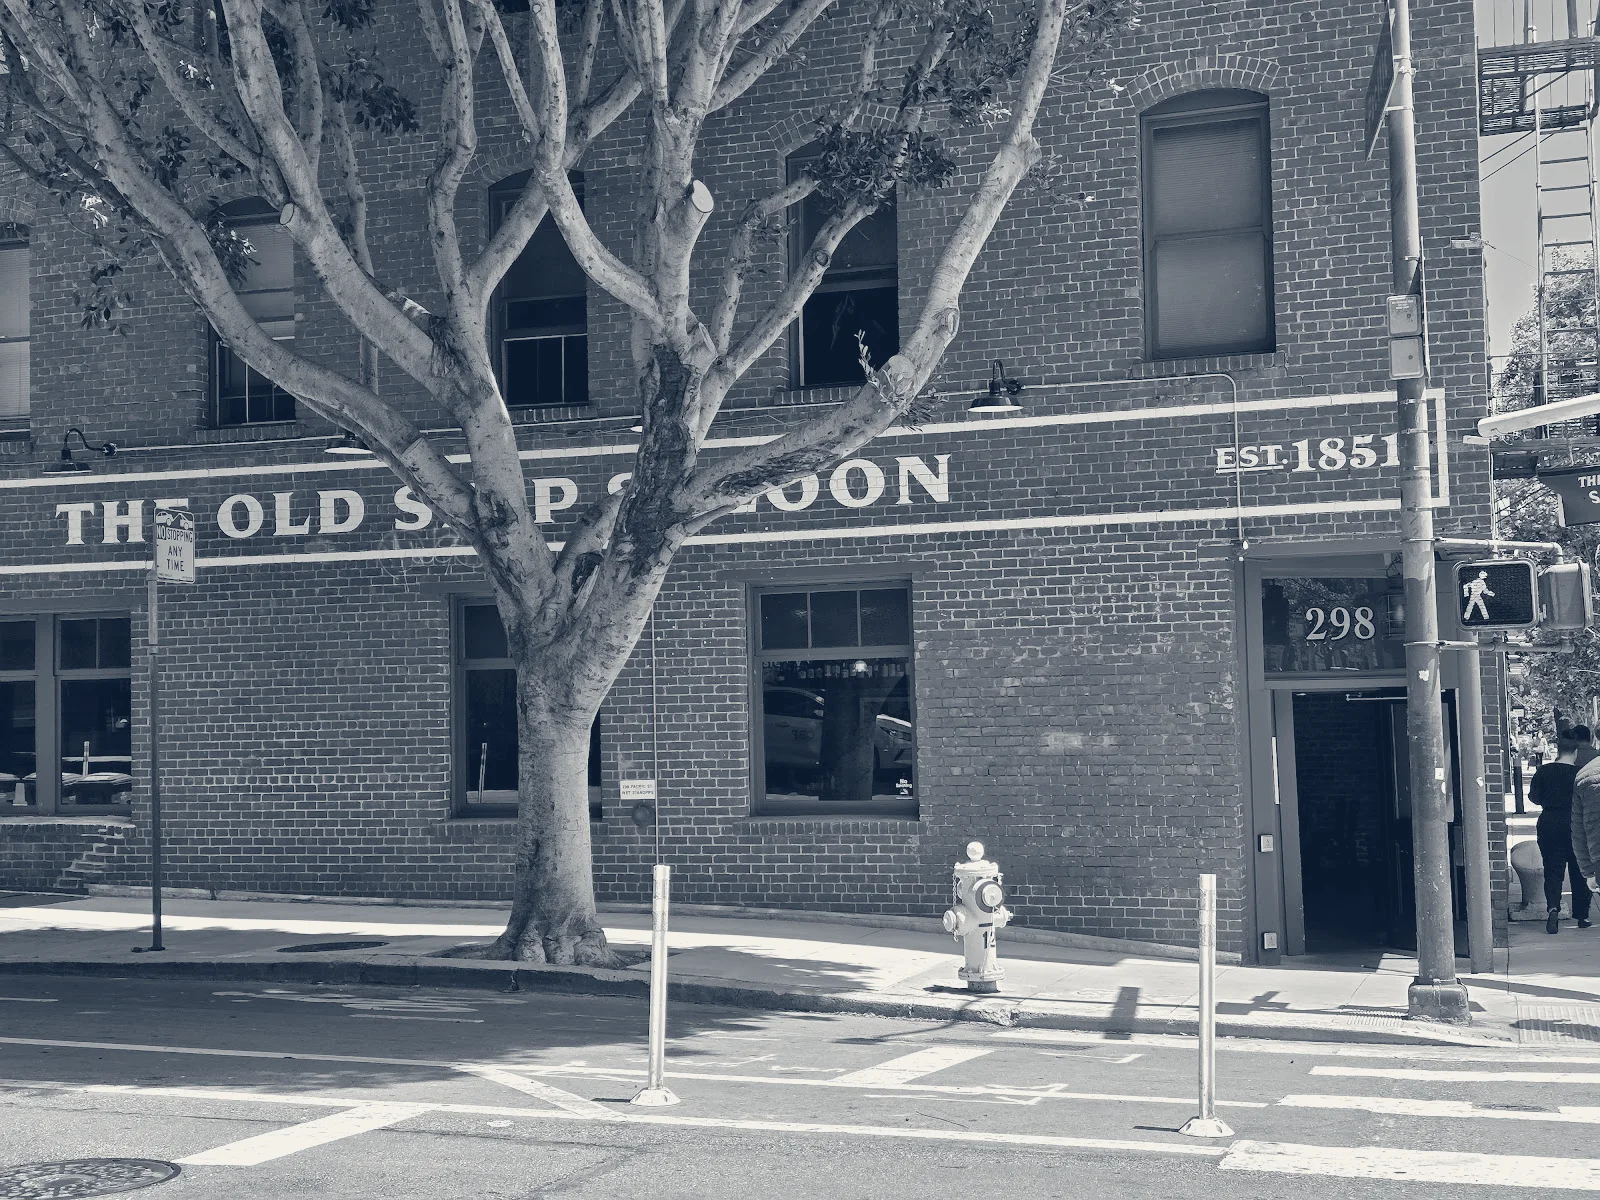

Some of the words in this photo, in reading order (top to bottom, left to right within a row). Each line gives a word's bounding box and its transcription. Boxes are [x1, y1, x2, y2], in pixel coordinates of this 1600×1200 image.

[1215, 444, 1288, 470] EST.
[1292, 432, 1400, 472] 1851
[55, 499, 188, 545] TH
[216, 489, 365, 539] OLD
[393, 477, 578, 531] SP
[607, 453, 952, 512] OON
[156, 524, 166, 540] NO
[166, 528, 193, 543] STOPPING
[168, 545, 183, 557] ANY
[166, 558, 185, 572] TIME
[1305, 607, 1376, 641] 298
